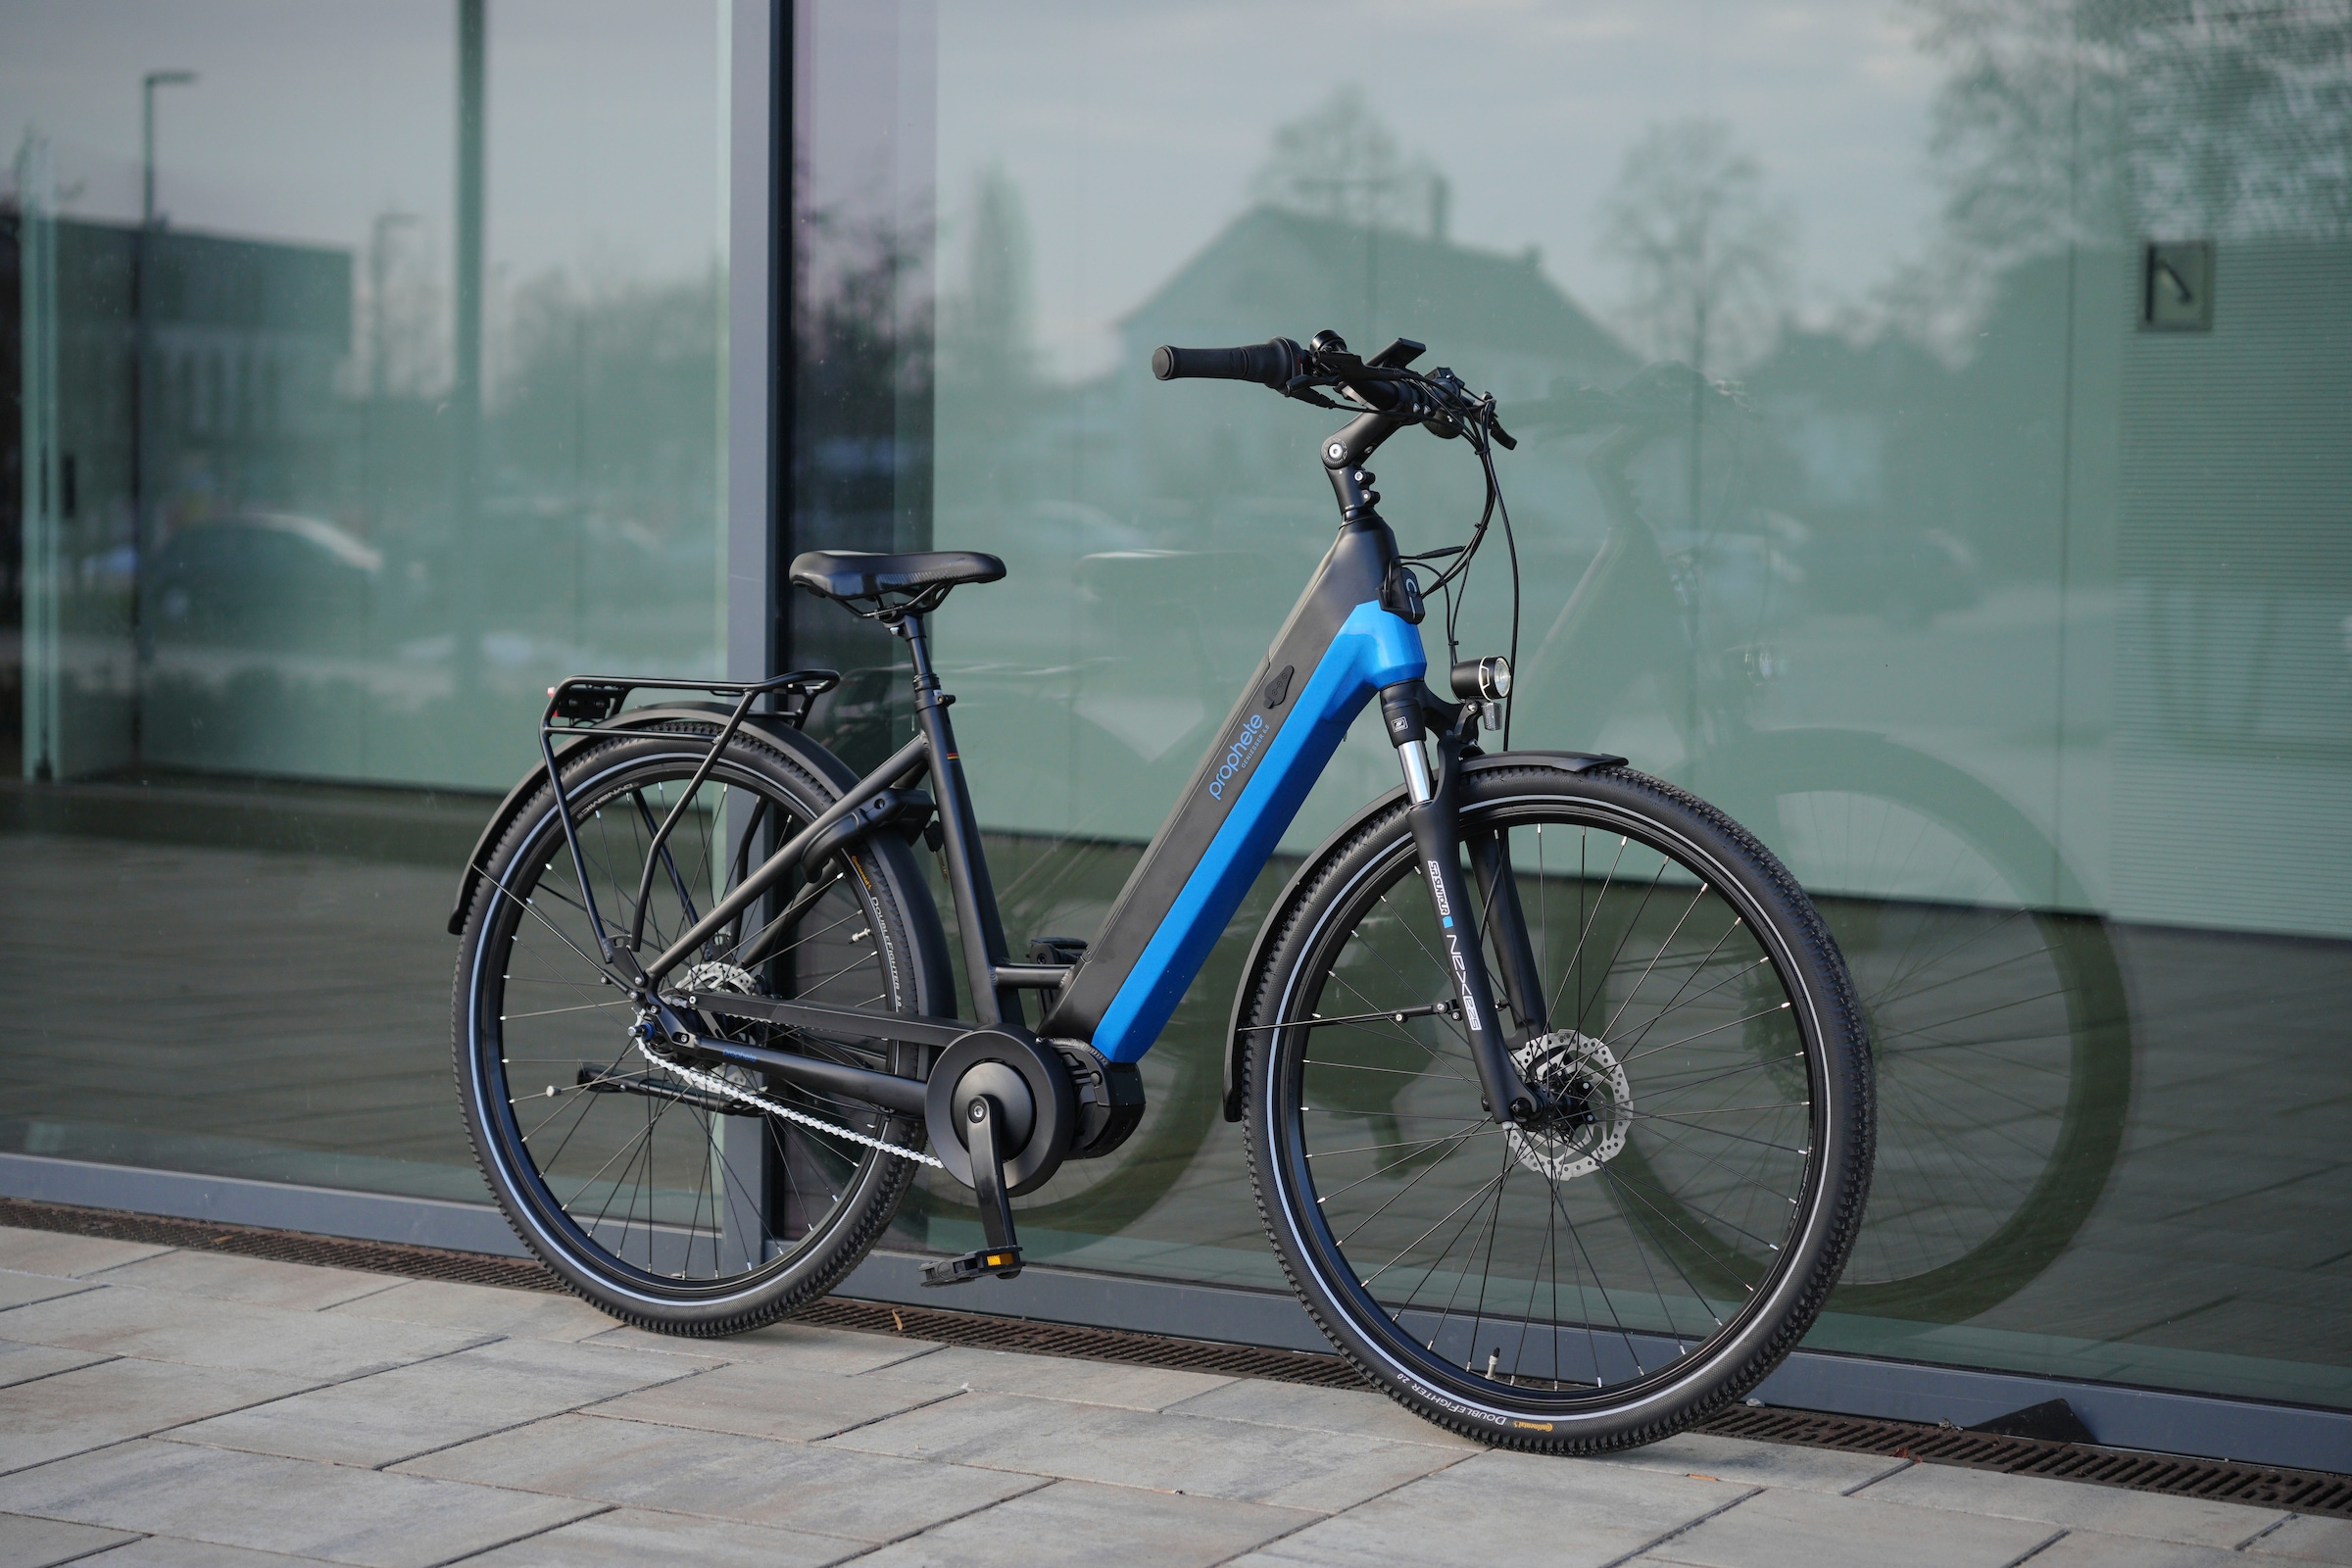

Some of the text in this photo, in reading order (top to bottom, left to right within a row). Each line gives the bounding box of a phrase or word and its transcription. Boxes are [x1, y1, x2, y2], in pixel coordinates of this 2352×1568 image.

[1208, 714, 1263, 801] prophete
[1242, 734, 1264, 768] GENIESSER
[851, 855, 870, 887] Continental
[1433, 877, 1449, 915] SUNTOUR
[1396, 1373, 1411, 1384] 2.0
[1517, 1421, 1553, 1433] Continental
